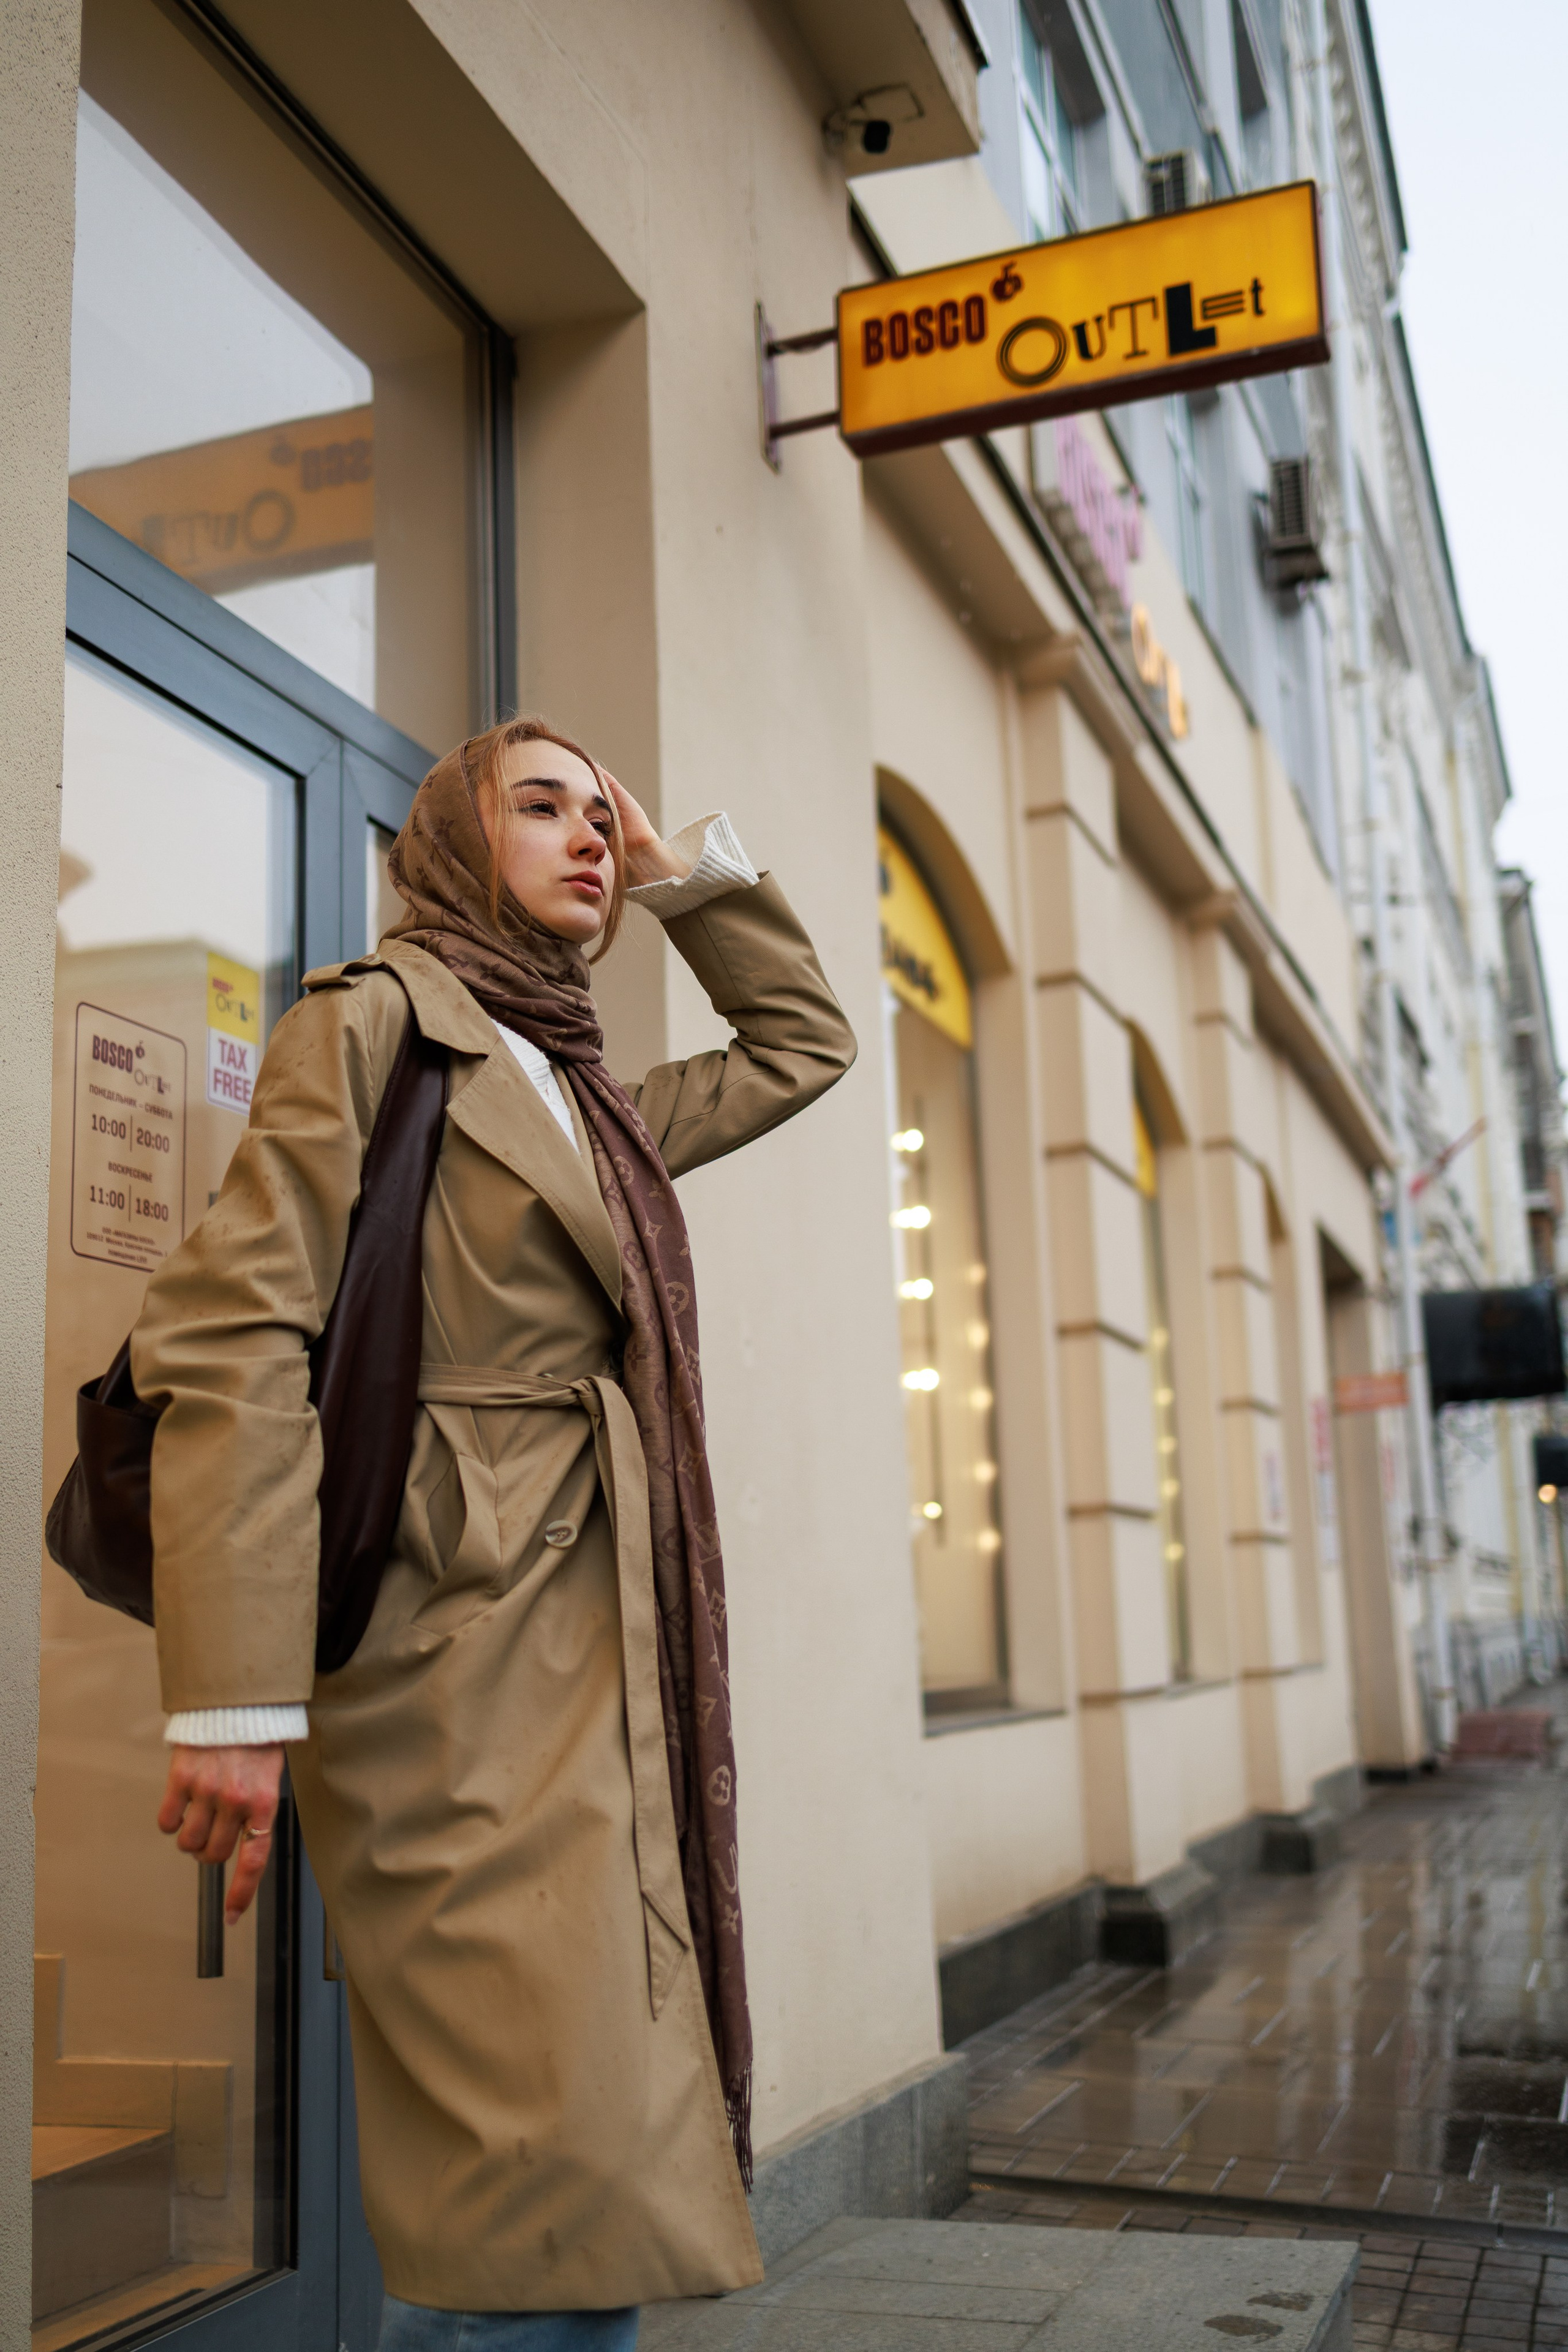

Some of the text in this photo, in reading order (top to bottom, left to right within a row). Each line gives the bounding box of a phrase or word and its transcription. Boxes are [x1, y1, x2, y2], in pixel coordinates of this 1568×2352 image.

[862, 293, 987, 368] BOSCO
[92, 1035, 134, 1074] BOSCO
[218, 1038, 247, 1072] TAX
[89, 1083, 173, 1120] ПОНЕДЕЛЬНИК СУББОТА
[213, 1068, 252, 1104] FREE
[92, 1114, 170, 1153] 10:00 20:00
[108, 1161, 153, 1183] ВОСКРЕСЕНЬЕ
[90, 1185, 169, 1222] 11:00 18:00
